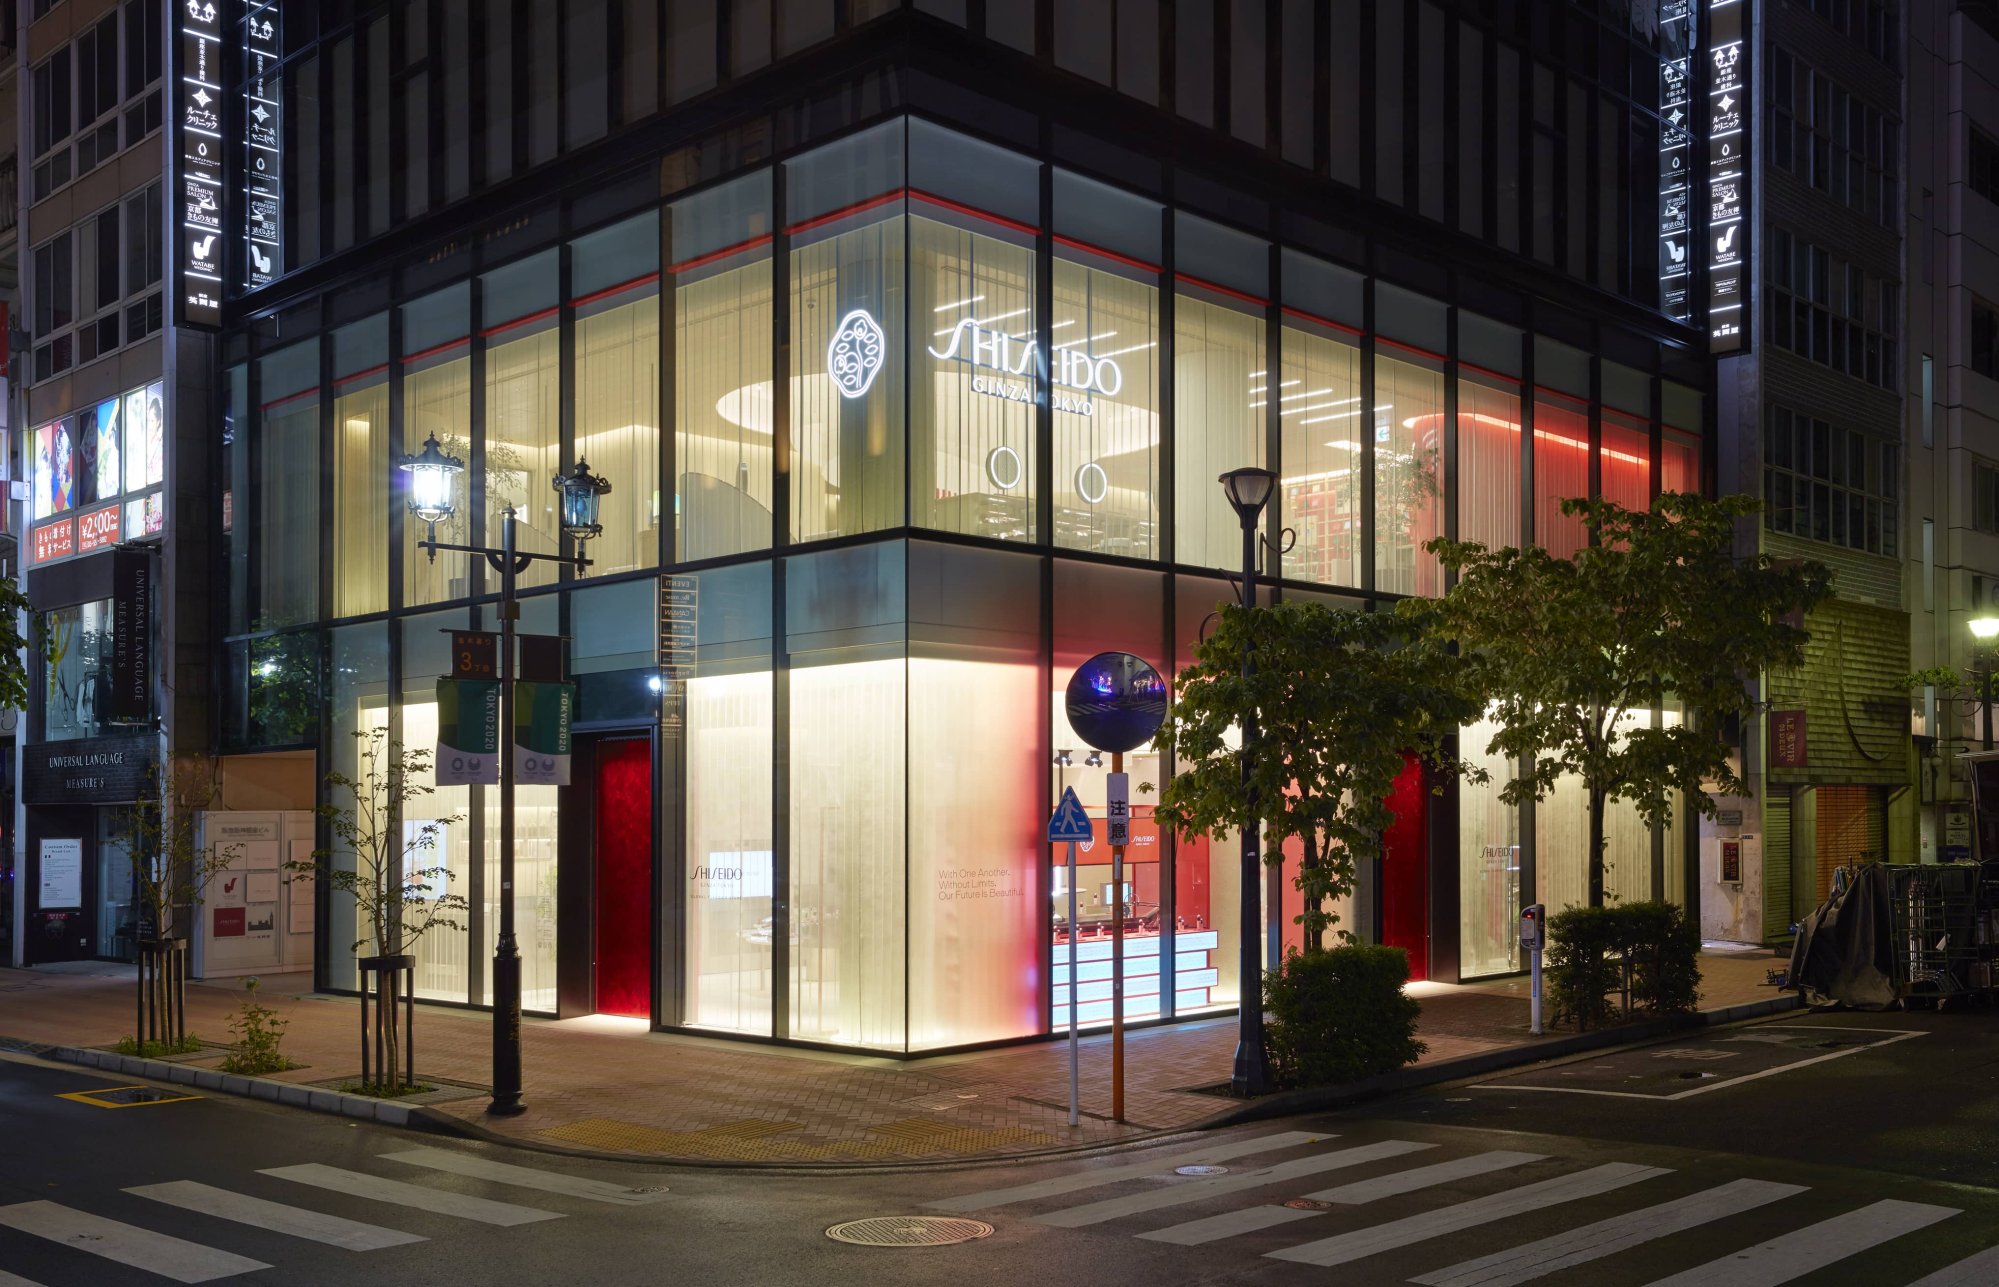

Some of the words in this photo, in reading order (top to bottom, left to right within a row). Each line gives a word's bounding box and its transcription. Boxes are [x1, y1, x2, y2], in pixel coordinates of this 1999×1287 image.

[187, 106, 217, 121] ルーチェ
[1713, 112, 1739, 124] ルーチェ
[187, 115, 218, 129] クリニック
[1713, 119, 1740, 132] クリニック
[187, 186, 214, 196] PREMIUM
[187, 191, 207, 199] SALON
[1715, 252, 1736, 260] WATABE
[191, 260, 215, 270] WATABE
[972, 377, 1031, 404] GINZA
[135, 569, 145, 632] UNIVERSAL
[134, 636, 144, 701] LANGUAGE
[485, 688, 496, 722] TOKYO
[560, 692, 569, 725] TOKYO
[484, 724, 496, 750] 2020
[558, 726, 567, 751] 2020
[49, 755, 84, 769] UNIVERSAL
[85, 752, 124, 766] LANGUAGE
[1110, 800, 1127, 839] 注意
[1131, 835, 1155, 843] SHISEIDO
[1479, 846, 1514, 858] SHISEIDO
[690, 866, 742, 880] SHISEIDO
[938, 869, 957, 879] With
[959, 868, 976, 879] One
[977, 868, 1011, 877] Another.
[938, 880, 970, 890] Without
[971, 879, 997, 888] Limits.
[938, 891, 953, 900] Our
[955, 890, 981, 899] Future
[989, 888, 1024, 898] Beautiful.
